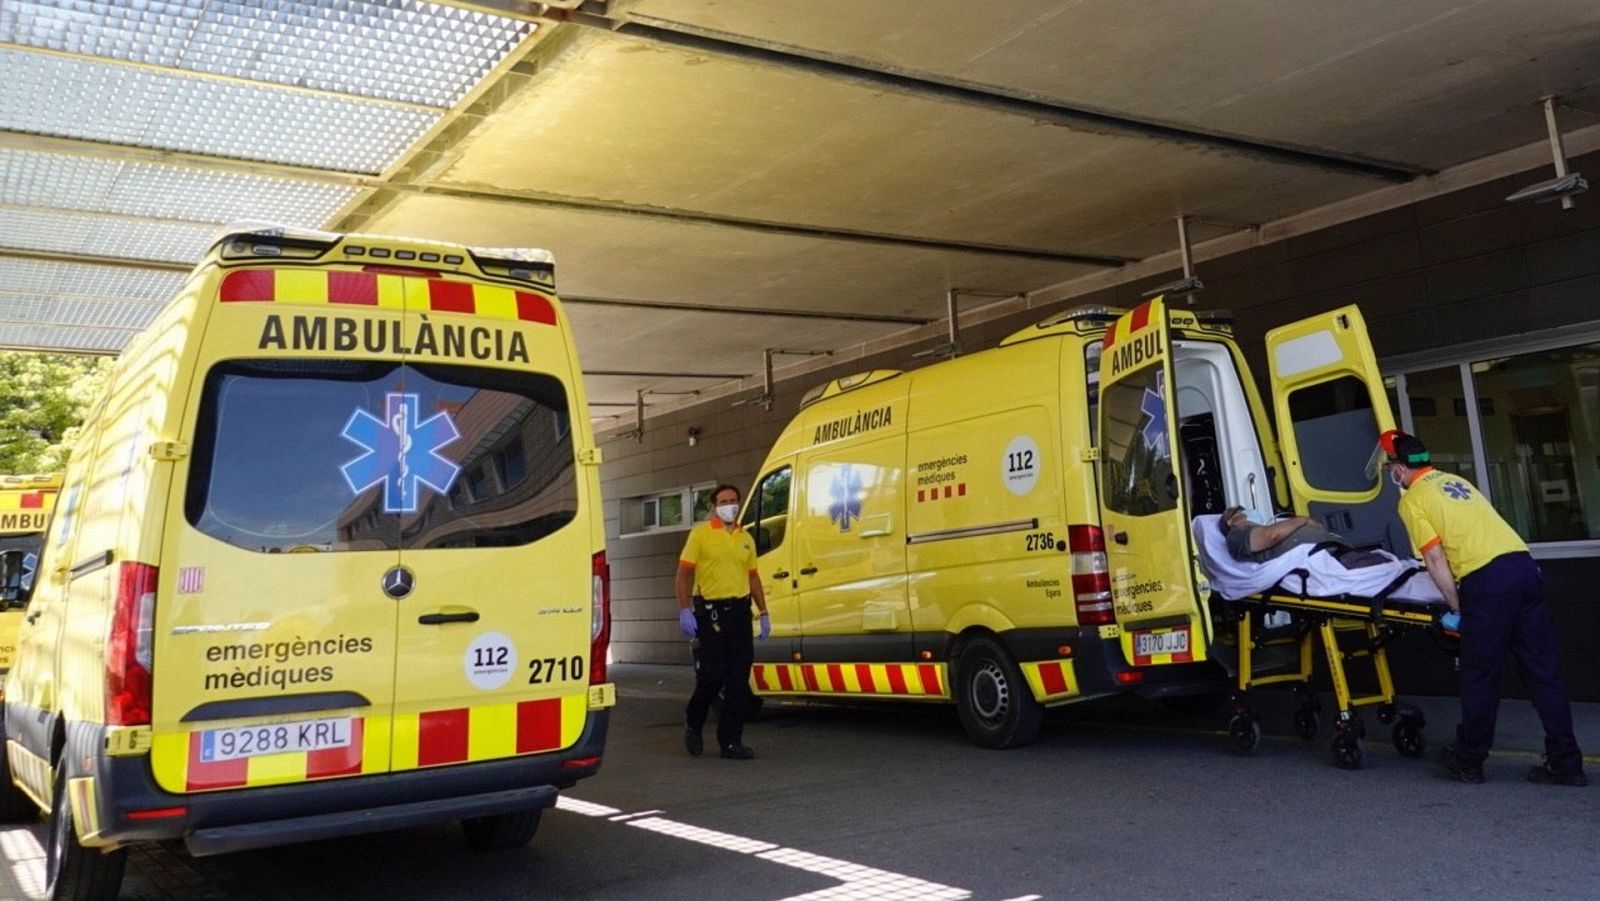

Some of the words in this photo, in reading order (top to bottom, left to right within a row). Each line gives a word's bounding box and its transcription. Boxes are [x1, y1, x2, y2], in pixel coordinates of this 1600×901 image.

[258, 313, 530, 364] AMBULÀNCIA
[1111, 329, 1164, 377] AMBUL
[813, 406, 892, 446] AMBULÀNCIA
[917, 454, 968, 472] emergències
[1008, 450, 1033, 473] 112
[917, 471, 956, 486] mèdiques
[0, 513, 51, 530] MBU
[1025, 532, 1055, 552] 2736
[205, 634, 373, 664] emergències
[1142, 634, 1164, 653] 3170
[473, 646, 509, 667] 112
[204, 664, 334, 690] mèdiques
[528, 655, 584, 685] 2710
[220, 726, 289, 756] 9288
[298, 721, 346, 748] KRL
